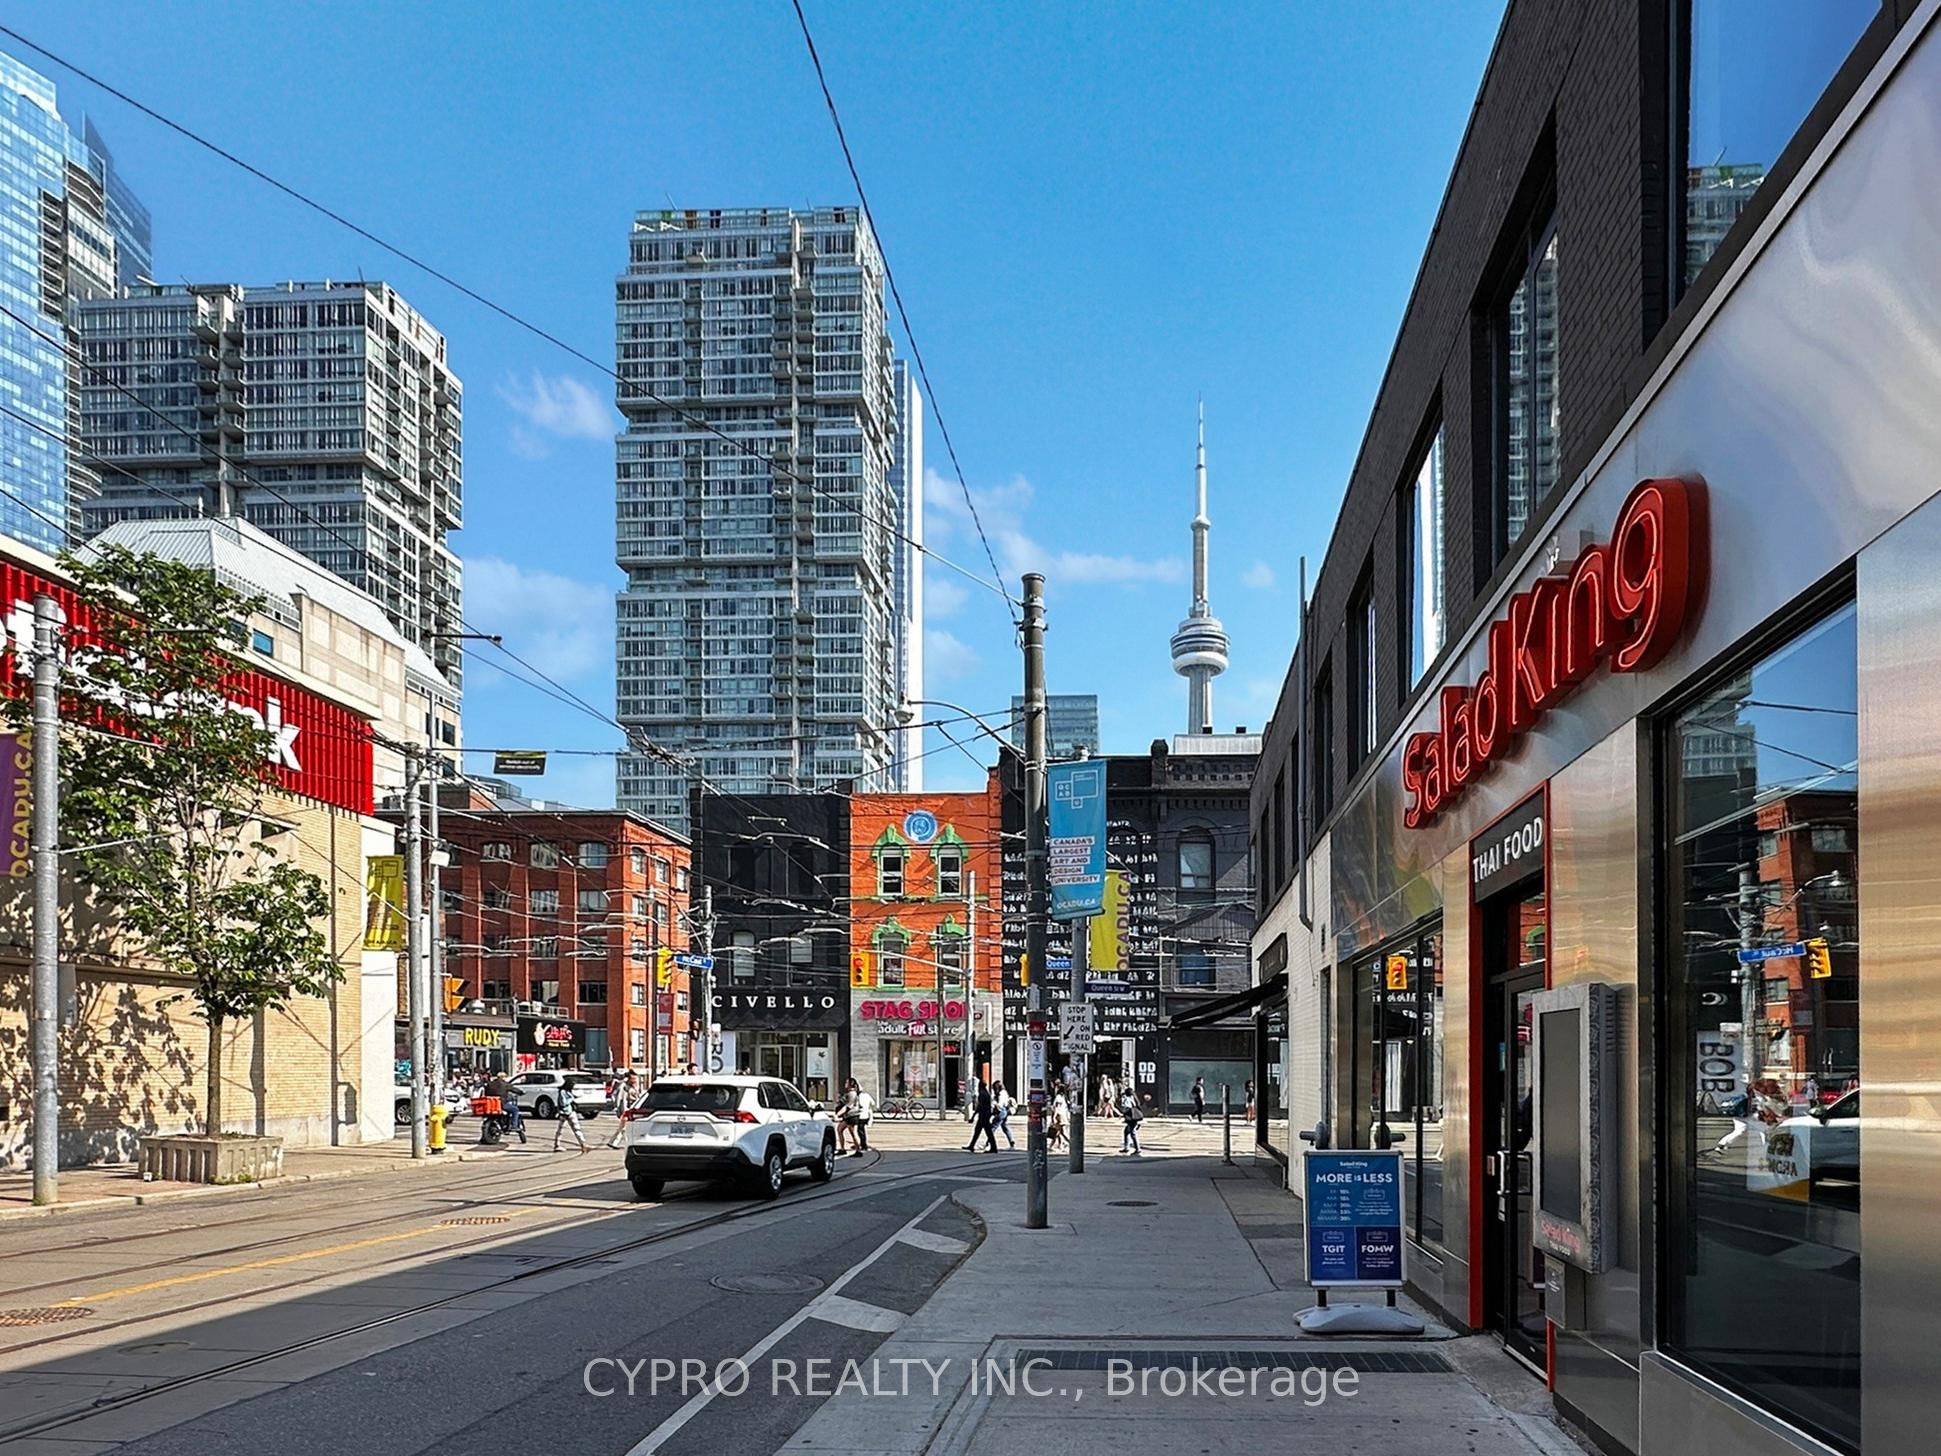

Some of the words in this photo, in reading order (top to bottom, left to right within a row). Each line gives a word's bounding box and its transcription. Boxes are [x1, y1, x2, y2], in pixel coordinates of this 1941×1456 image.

[1053, 838, 1093, 846] CANADA'S
[1053, 847, 1088, 855] LARGEST
[1472, 841, 1500, 884] THAI
[1502, 816, 1543, 866] FOOD
[1053, 867, 1082, 875] DESIGN
[1053, 876, 1098, 885] UNIVERSITY
[1056, 898, 1096, 909] OCADU.CA
[1046, 959, 1070, 967] Queen
[1091, 984, 1113, 992] Queen
[711, 996, 835, 1008] CIVELLO
[861, 1001, 913, 1019] STAG
[1068, 1006, 1086, 1014] STOP
[878, 1024, 907, 1034] adult
[928, 1025, 960, 1035] stre
[464, 1028, 500, 1046] RUDY
[1138, 1072, 1156, 1083] TO
[1315, 1173, 1353, 1183] MORE
[1362, 1173, 1393, 1183] LESS
[1321, 1245, 1346, 1253] TGIT
[1361, 1245, 1394, 1253] FOMW
